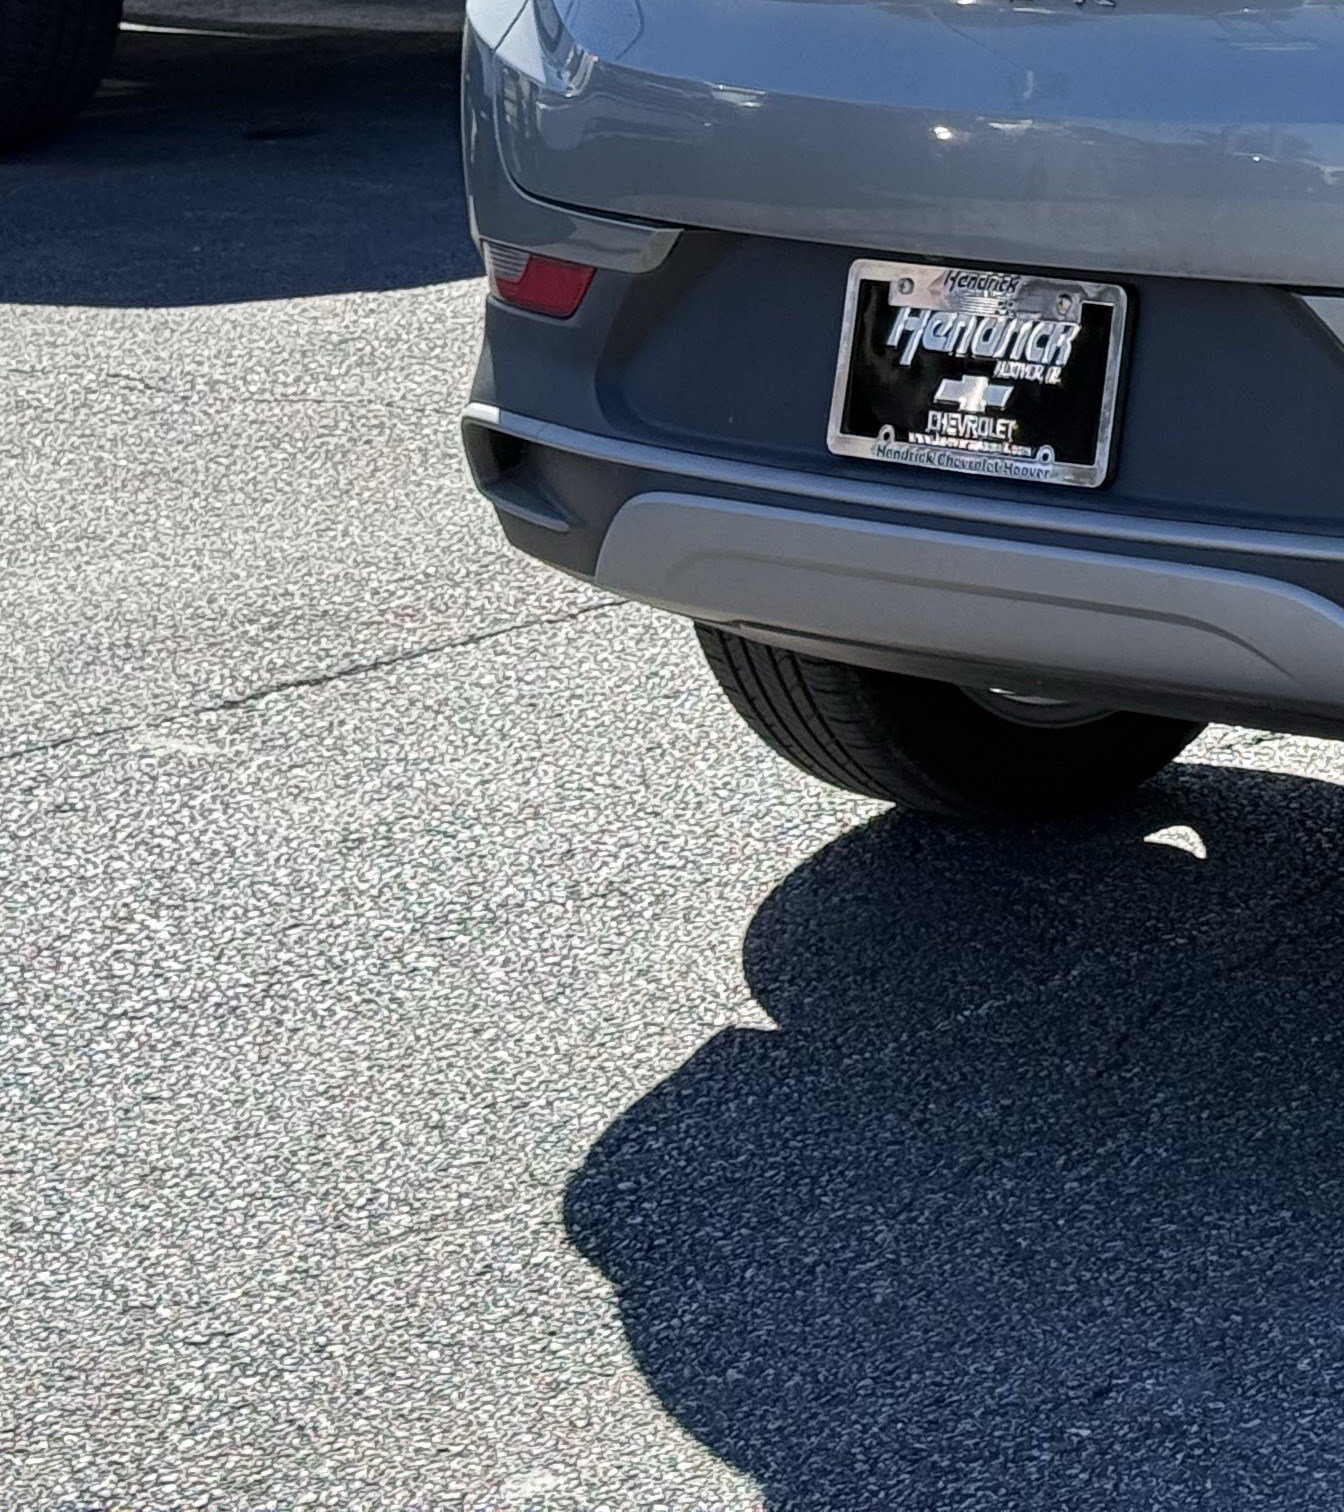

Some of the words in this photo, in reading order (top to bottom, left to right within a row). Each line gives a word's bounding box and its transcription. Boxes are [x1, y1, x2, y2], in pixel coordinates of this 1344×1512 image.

[944, 269, 1022, 295] Hendrick
[886, 306, 1081, 366] Hendrick
[925, 410, 1017, 442] CHEVROLET
[875, 444, 934, 466] Hendrick
[937, 453, 1000, 474] Chevrolet
[1002, 461, 1051, 480] Hoover
